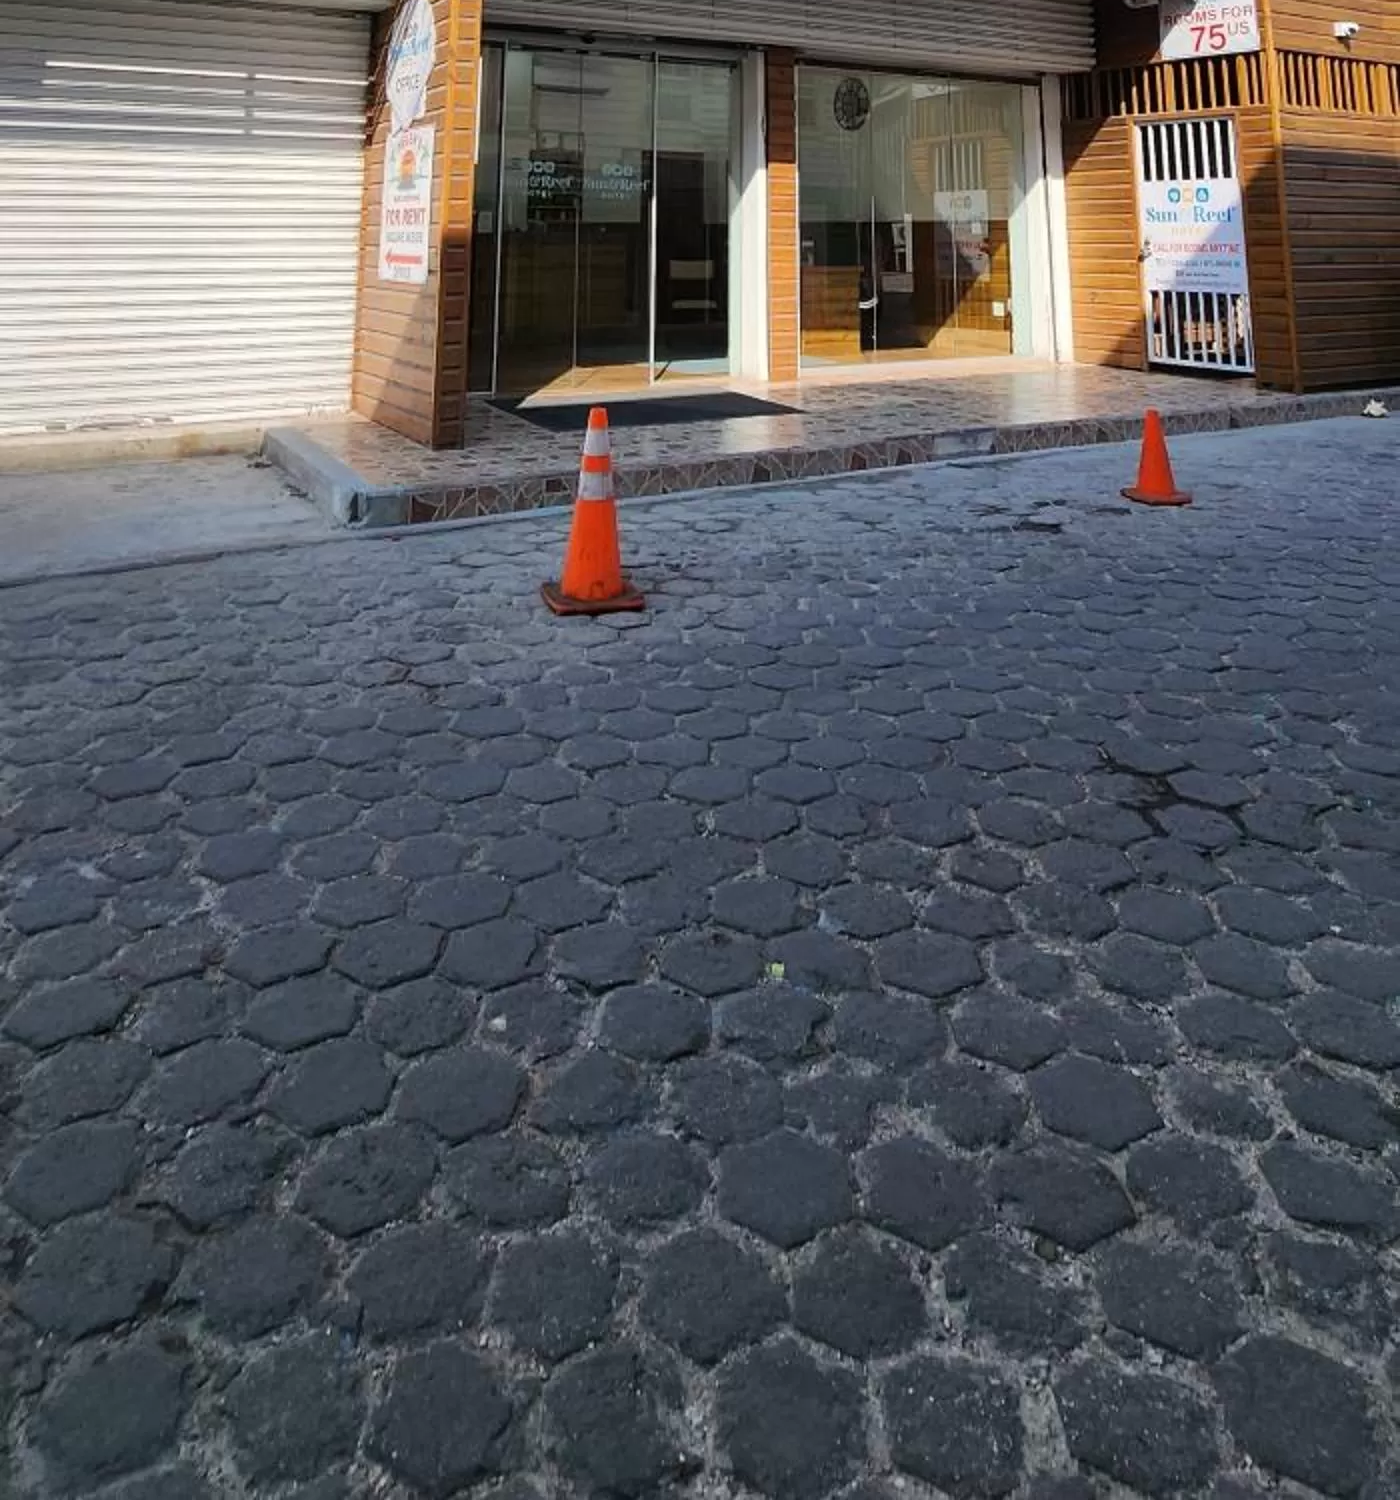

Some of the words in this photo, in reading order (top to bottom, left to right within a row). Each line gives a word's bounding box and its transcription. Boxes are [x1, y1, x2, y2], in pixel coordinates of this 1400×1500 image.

[1163, 8, 1217, 27] ROOMS
[1221, 5, 1253, 20] FOR
[1190, 23, 1227, 52] 75
[1228, 21, 1250, 36] US
[386, 209, 401, 226] FOR
[403, 207, 427, 226] RENT
